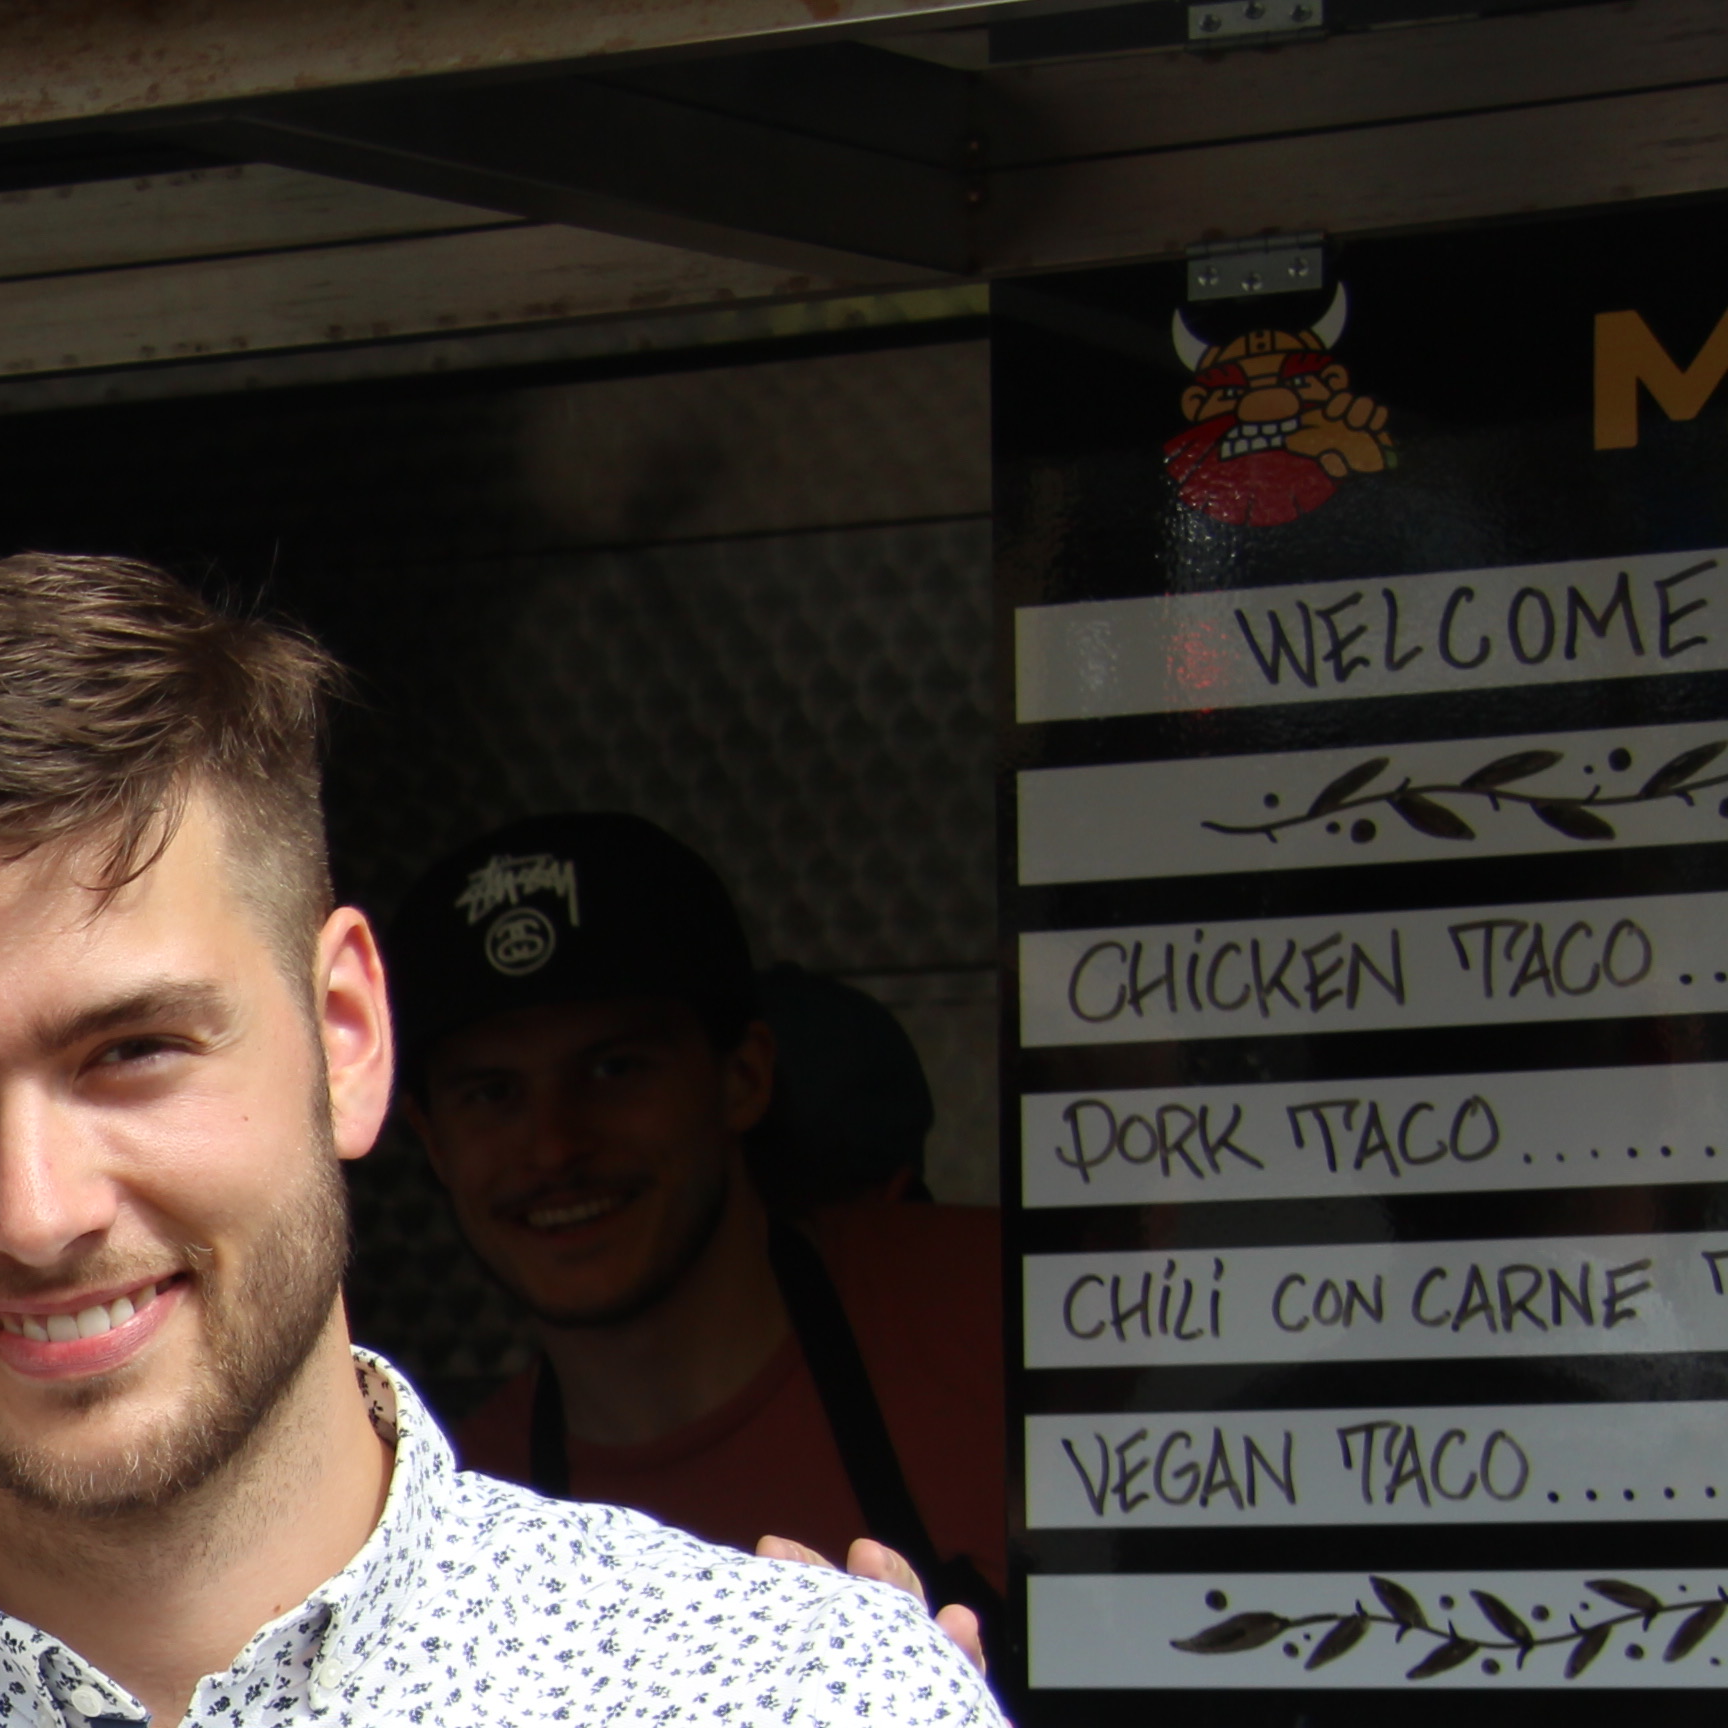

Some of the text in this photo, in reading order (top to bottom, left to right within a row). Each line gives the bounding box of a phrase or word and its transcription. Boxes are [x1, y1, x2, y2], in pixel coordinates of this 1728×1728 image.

[1234, 559, 1719, 688] WELCOME
[1412, 1259, 1652, 1333] CARNE
[1061, 1426, 1297, 1517] VEGAN
